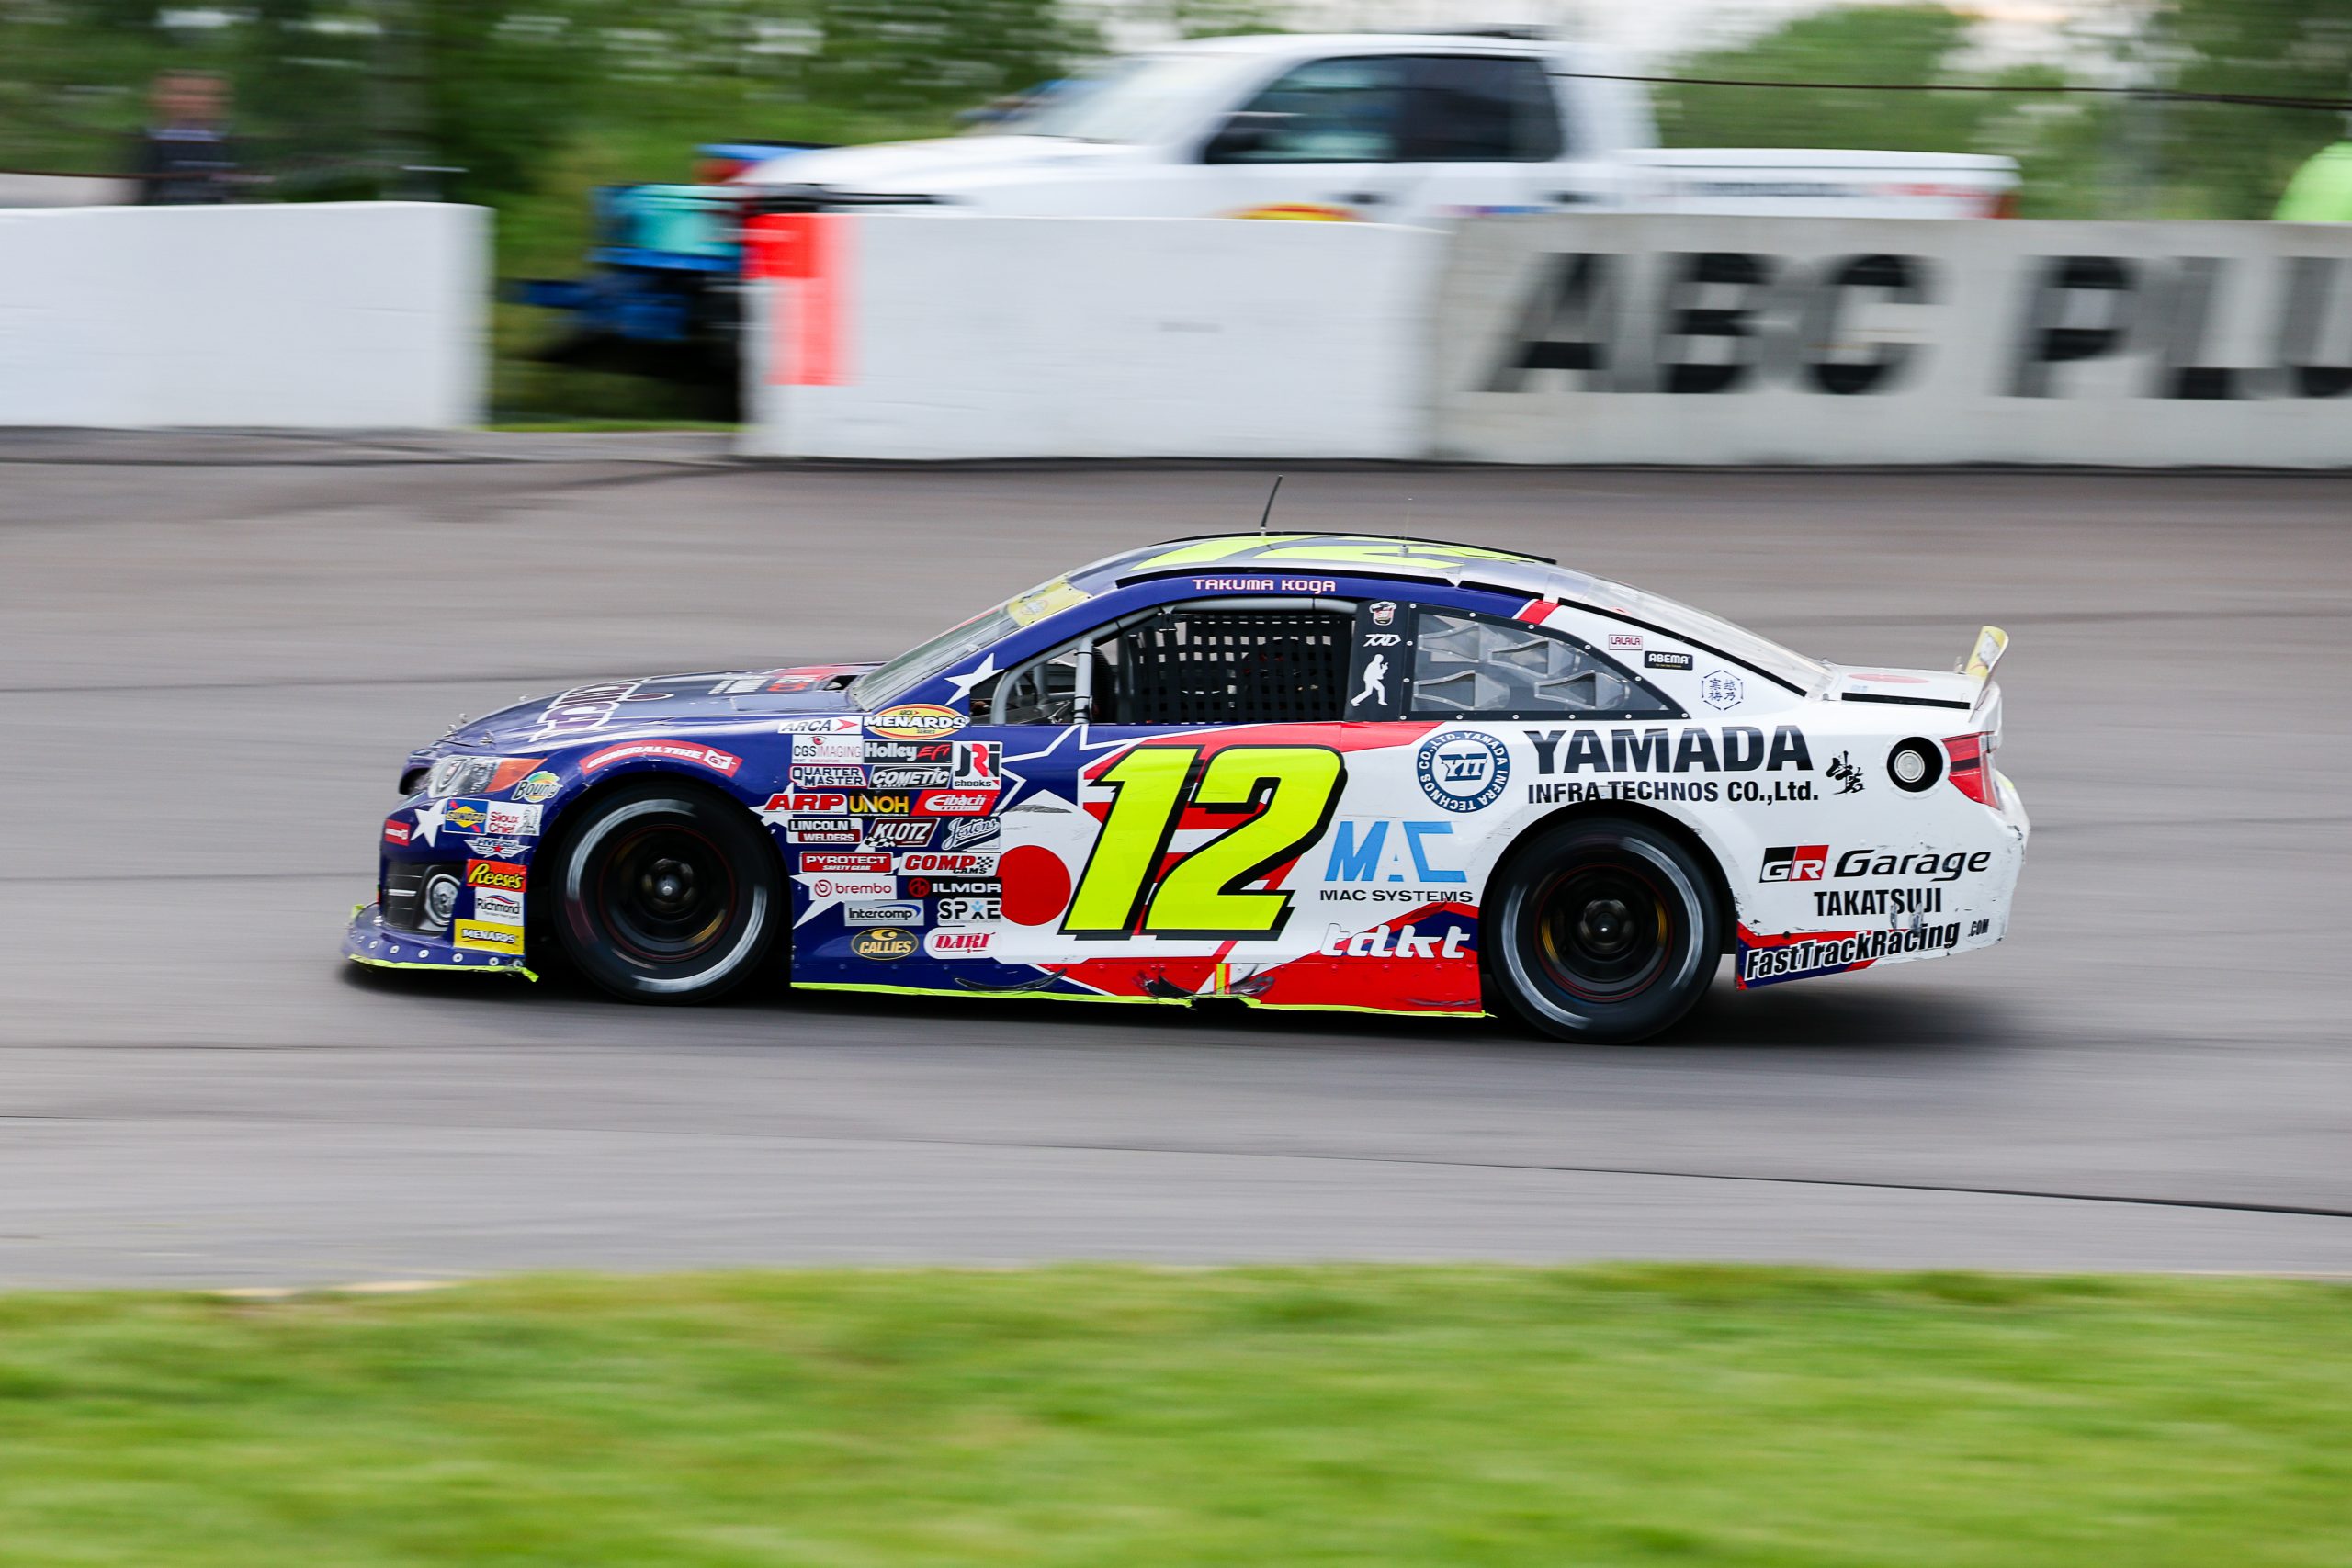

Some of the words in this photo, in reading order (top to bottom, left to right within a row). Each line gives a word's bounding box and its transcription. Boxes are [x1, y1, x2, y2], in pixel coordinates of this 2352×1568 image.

[1473, 252, 1943, 395] ABC
[1192, 578, 1274, 591] TAKUMA
[1648, 653, 1689, 664] ABEMA
[781, 719, 831, 732] ARCA
[864, 716, 967, 729] MENARDS
[865, 742, 918, 761] Holley
[1464, 732, 1508, 766] YAMADA
[1523, 725, 1815, 774] YAMADA
[792, 766, 861, 780] QUARTER
[872, 770, 950, 784] COMETIC
[804, 775, 864, 786] MASTER
[954, 779, 992, 787] shocks
[1419, 773, 1477, 811] TECHNOS
[1477, 770, 1509, 806] INFRA
[1528, 782, 1599, 805] INFRA
[1606, 780, 1718, 803] TECHNOS
[764, 795, 844, 810] ARP
[849, 795, 909, 813] UNOH
[924, 795, 987, 811] Eibach
[490, 811, 519, 824] Sioux
[489, 822, 515, 834] Chief
[790, 820, 849, 830] LINCOLN
[874, 823, 933, 840] KLOTZ
[803, 833, 854, 842] WELDERS
[1057, 744, 1348, 941] 12
[806, 855, 888, 864] PYROTECT
[905, 854, 976, 871] COMP
[1761, 859, 1825, 881] GR
[1834, 849, 1991, 882] Garage
[468, 863, 525, 889] Reese's
[835, 883, 892, 894] brembo
[932, 882, 1001, 893] ILMOR
[1319, 890, 1367, 901] MAC
[1372, 890, 1474, 903] SYSTEMS
[1814, 888, 1942, 917] TAKATSUJI
[475, 897, 521, 915] Richmond
[848, 908, 913, 920] Intercomp
[461, 928, 516, 944] MENARDS
[858, 939, 912, 953] CALLIES
